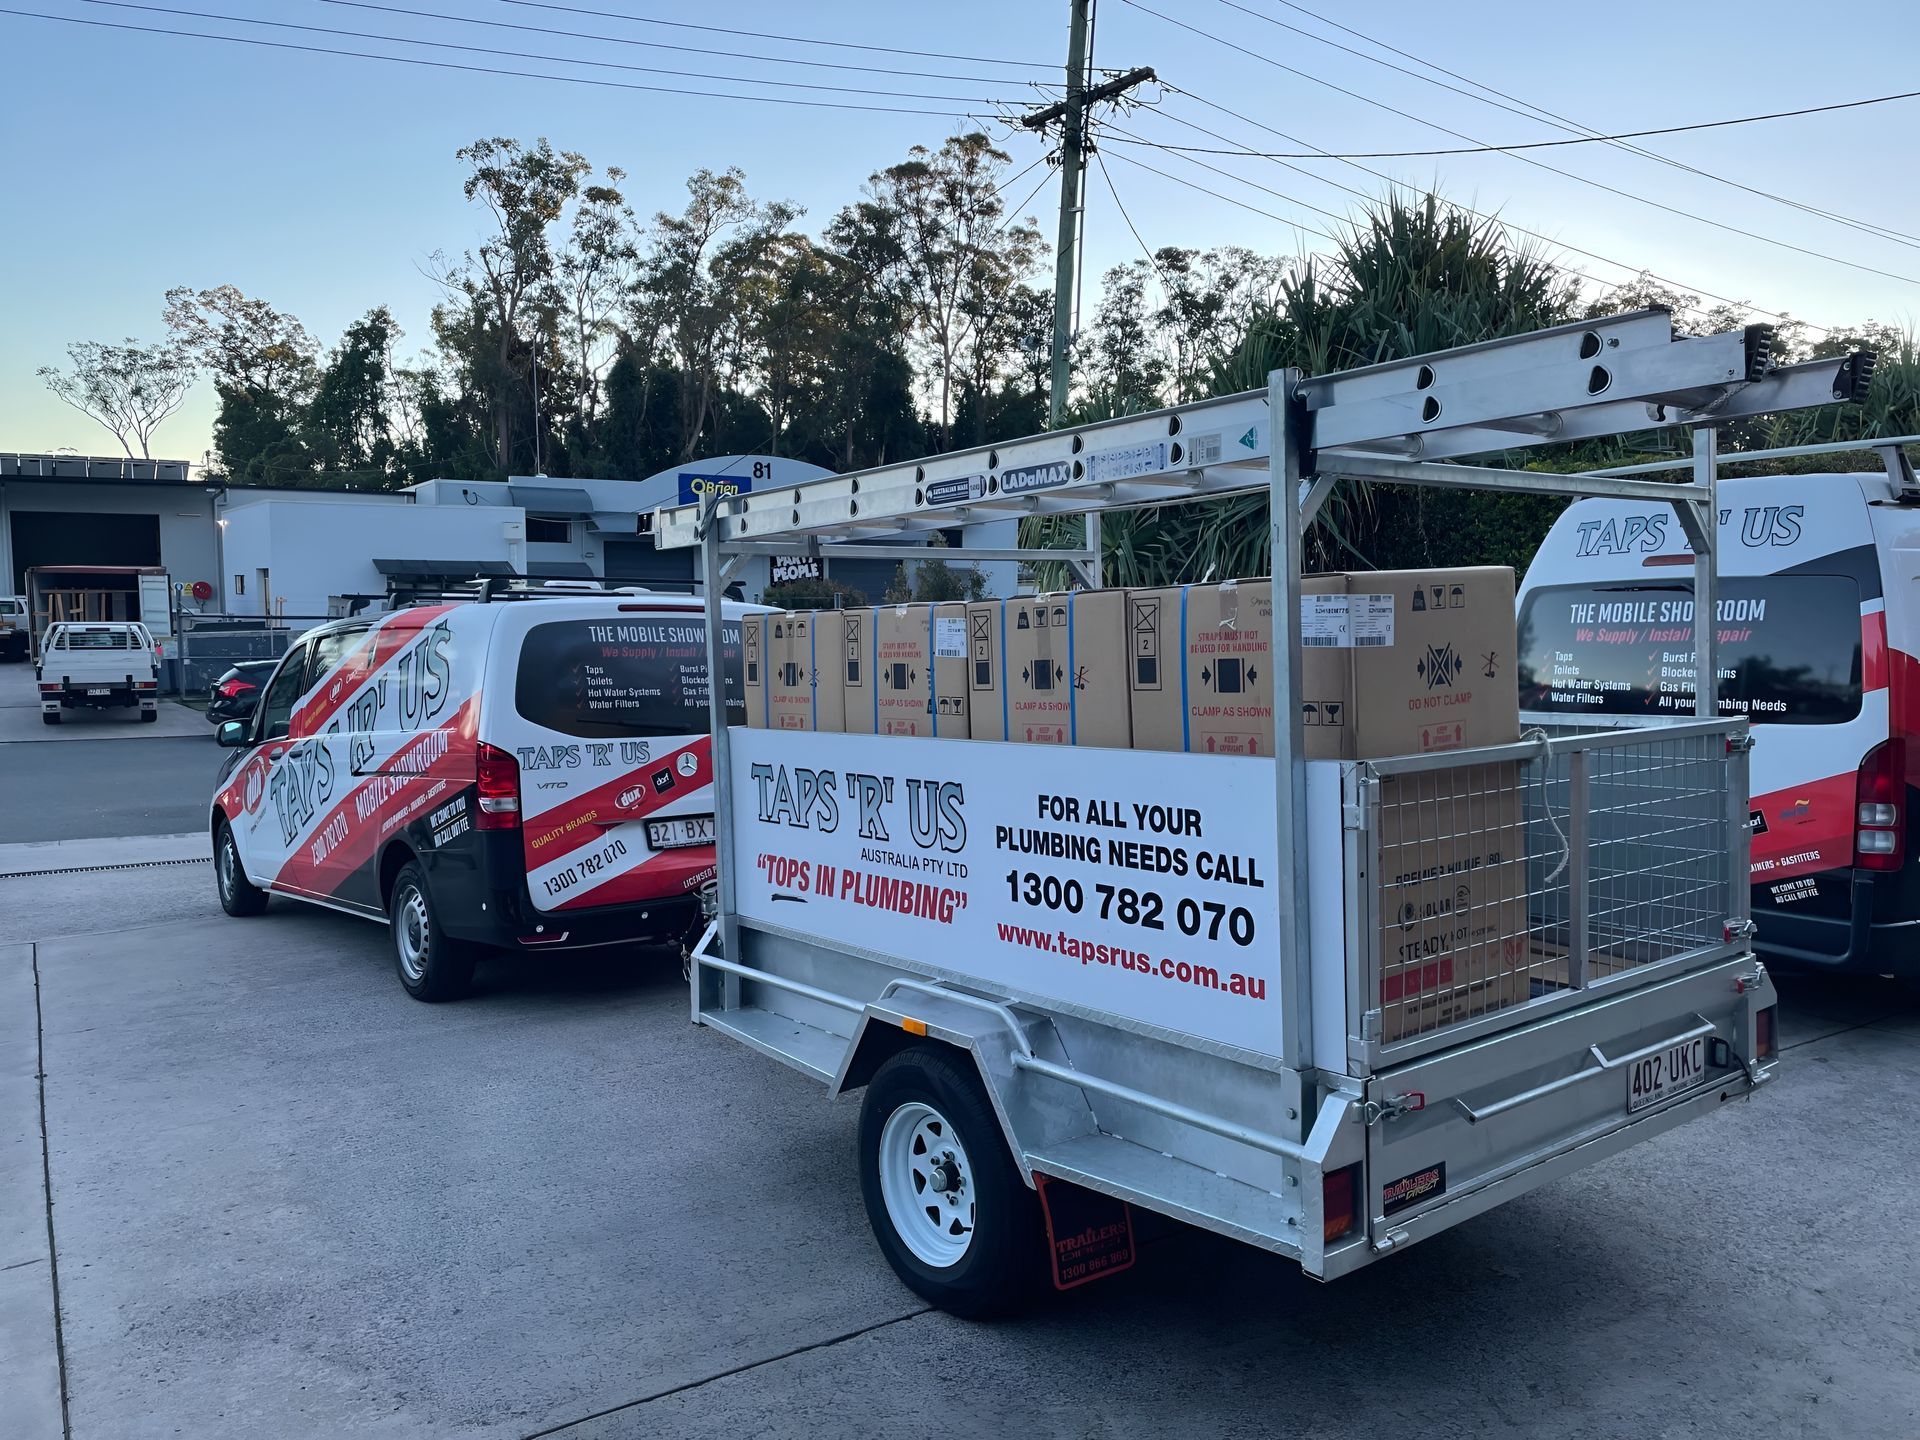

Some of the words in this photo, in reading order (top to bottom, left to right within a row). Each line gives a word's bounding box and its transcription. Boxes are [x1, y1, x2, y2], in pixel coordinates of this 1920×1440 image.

[753, 461, 772, 480] 81
[1001, 464, 1070, 490] LADaMAX
[690, 478, 739, 495] O'Brien
[1576, 513, 1668, 557] TAPS
[1741, 505, 1804, 548] US
[772, 563, 820, 583] PEOPLE
[1570, 603, 1595, 624] THE
[1598, 601, 1657, 624] MOBILE
[1660, 599, 1766, 623] SHOOOM
[588, 625, 615, 643] THE
[617, 626, 667, 643] MOBILE
[668, 627, 741, 645] SHOWOM
[1198, 632, 1222, 642] STRAPS
[1223, 631, 1242, 641] MUST
[1244, 630, 1259, 640] NOT
[1576, 628, 1593, 642] We
[1597, 628, 1638, 645] Supply
[1649, 628, 1691, 642] Install
[1716, 627, 1752, 645] epair
[602, 646, 619, 658] We
[622, 647, 657, 660] Supply
[666, 647, 697, 658] Install
[850, 646, 855, 656] 2
[979, 645, 985, 656] 2
[1142, 639, 1150, 650] 2
[1190, 644, 1199, 654] BE
[1200, 644, 1216, 654] USED
[1217, 643, 1231, 653] FOR
[1232, 641, 1268, 652] HANDLING
[1555, 651, 1573, 662] Taps
[1663, 652, 1688, 663] Burst
[585, 665, 604, 676] Taps
[680, 665, 699, 673] Burst
[1553, 664, 1580, 676] Toilets
[586, 677, 613, 686] Toilets
[1552, 679, 1567, 689] Hot
[1568, 680, 1592, 690] Water
[1594, 680, 1631, 693] Systems
[1660, 681, 1684, 692] Gas
[588, 688, 602, 698] Hot
[605, 688, 628, 697] Water
[629, 688, 661, 699] Systems
[683, 687, 697, 696] Gas
[1551, 691, 1575, 703] Water
[1576, 693, 1604, 704] Filters
[589, 700, 613, 709] Water
[615, 700, 640, 708] Filters
[684, 698, 694, 706] All
[879, 699, 896, 707] CLAMP
[896, 699, 904, 707] AS
[904, 699, 924, 708] SHOWN
[1015, 701, 1037, 711] CLAMP
[1037, 702, 1048, 711] AS
[1049, 702, 1071, 711] SHOW
[1408, 698, 1421, 711] DO
[1423, 695, 1441, 709] NOT
[1443, 691, 1472, 706] CLAMP
[1658, 696, 1673, 707] All
[1674, 698, 1697, 710] your
[1718, 698, 1749, 712] mbing
[1752, 699, 1787, 712] Needs
[1191, 706, 1221, 717] CLAMP
[1222, 706, 1235, 717] AS
[1236, 706, 1272, 718] SHOWN
[270, 719, 340, 848] TAPS
[398, 618, 452, 733] US
[516, 743, 581, 771] TAPS
[586, 743, 614, 767] 'R'
[619, 741, 650, 765] US
[536, 781, 568, 790] VITO
[656, 773, 670, 787] dorf
[323, 823, 338, 854] 782
[334, 811, 349, 842] 070
[355, 775, 389, 824] MOBILE
[389, 730, 449, 796] SHOWROOM
[620, 786, 641, 807] dux
[430, 813, 439, 829] WE
[449, 802, 457, 816] TO
[456, 796, 466, 812] YOU
[751, 762, 839, 834] TAPS
[846, 773, 894, 842] 'R'
[906, 778, 967, 854] US
[1038, 794, 1080, 824] FOR
[1085, 799, 1127, 829] ALL
[1132, 803, 1203, 837] YOUR
[441, 827, 453, 844] CALL
[451, 821, 461, 838] OUT
[460, 816, 470, 833] FEE
[531, 826, 565, 849] QUALITY
[566, 810, 598, 832] BRANDS
[860, 847, 920, 871] AUSTRALIA
[923, 857, 943, 875] PTY
[947, 861, 968, 879] LTD
[995, 825, 1101, 864] PLUMBING
[1108, 839, 1189, 877] NEEDS
[1195, 851, 1264, 888] CALL
[1780, 850, 1820, 867] GASFITTERS
[543, 869, 579, 896] 1300
[576, 851, 605, 880] 782
[605, 839, 628, 866] 070
[683, 867, 712, 889] LICENSED
[1770, 885, 1780, 894] WE
[1780, 881, 1796, 892] COME
[1796, 880, 1804, 888] TO
[1804, 878, 1815, 887] YOU
[757, 853, 811, 892] “TOPS
[815, 864, 836, 897] IN
[840, 869, 968, 924] PLUMBING”
[1784, 891, 1798, 902] CALL
[1006, 869, 1084, 914] 1300
[1095, 883, 1165, 931] 782
[1176, 897, 1255, 947] 070
[1419, 897, 1451, 918] SOLAR
[997, 922, 1266, 1001] www.tapsrus.com.au
[1405, 1178, 1440, 1201] DIRECT
[1055, 1220, 1127, 1253] TRAILERS
[1062, 1263, 1086, 1280] 1300
